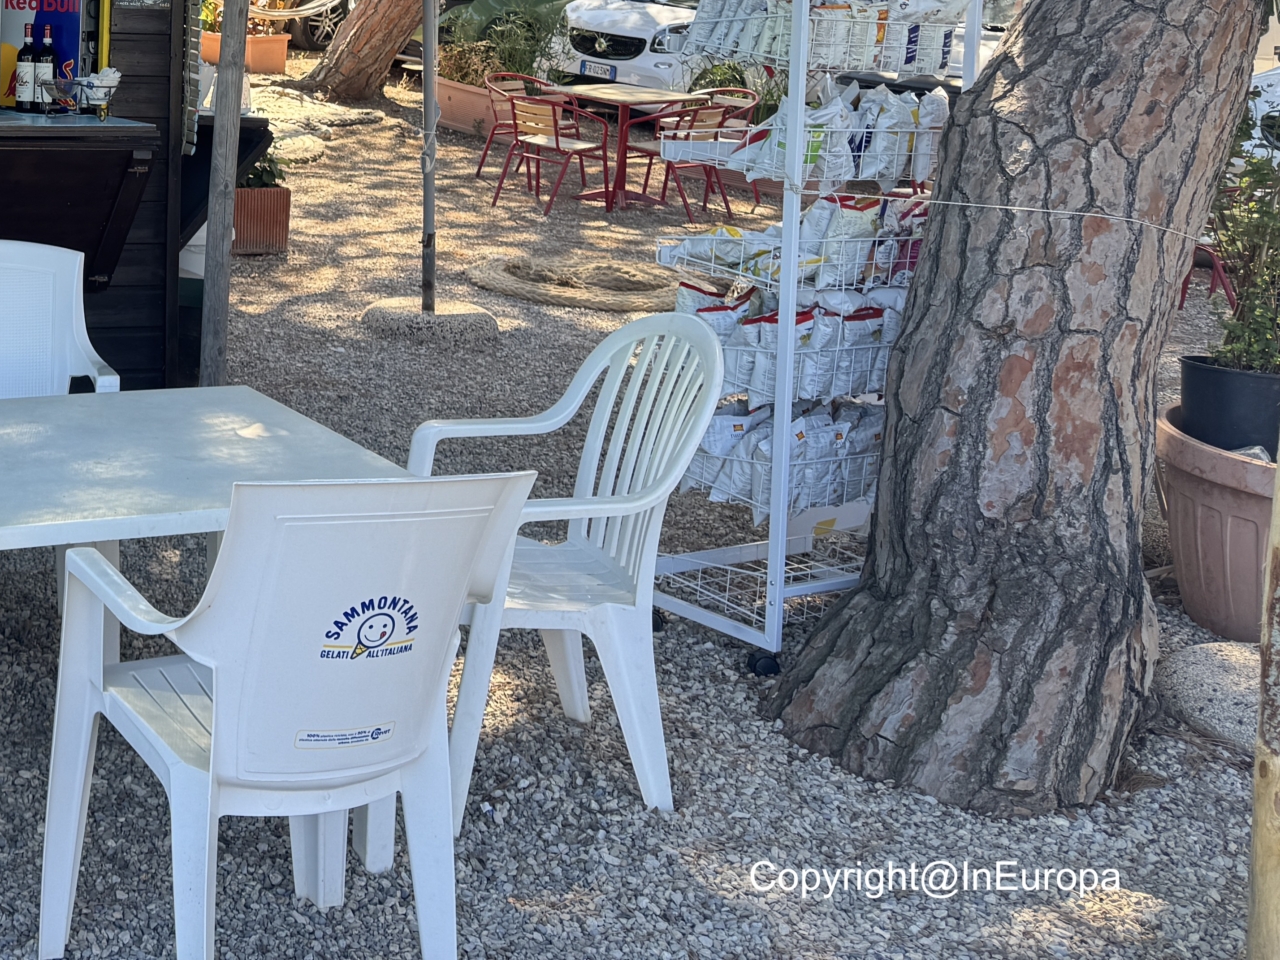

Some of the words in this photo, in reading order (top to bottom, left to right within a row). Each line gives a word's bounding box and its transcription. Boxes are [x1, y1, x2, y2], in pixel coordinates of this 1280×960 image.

[325, 596, 419, 641] SAMMONTANA
[320, 649, 349, 660] GELATI
[366, 643, 413, 659] ALL'ITALIANA
